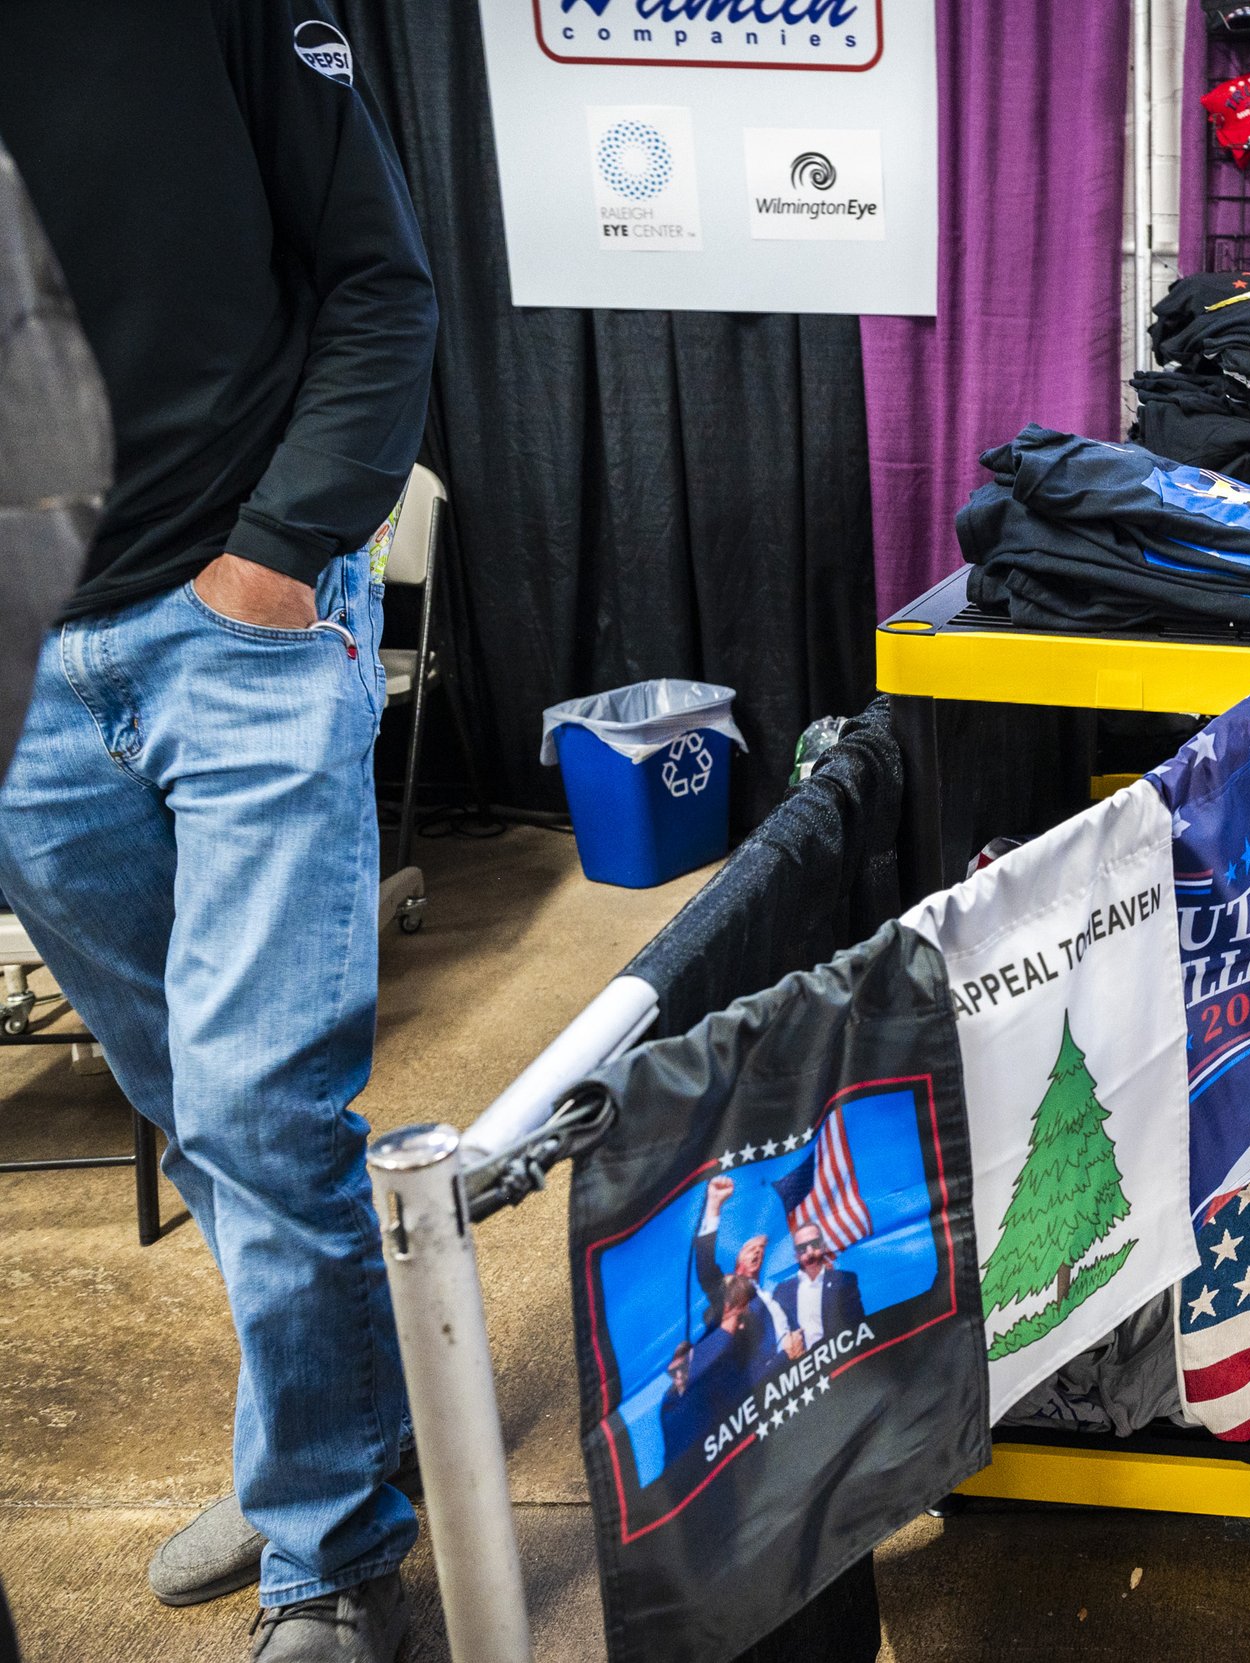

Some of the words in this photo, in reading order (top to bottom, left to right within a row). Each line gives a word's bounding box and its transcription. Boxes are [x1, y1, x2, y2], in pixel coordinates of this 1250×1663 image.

[562, 26, 857, 47] companies
[301, 52, 350, 69] PEPSI
[600, 207, 654, 220] RALEIGH
[602, 224, 629, 237] EYE
[633, 224, 684, 238] CENTER
[1058, 932, 1088, 970] TO
[703, 1396, 760, 1462] SAVE
[764, 1321, 876, 1410] AMERICA
